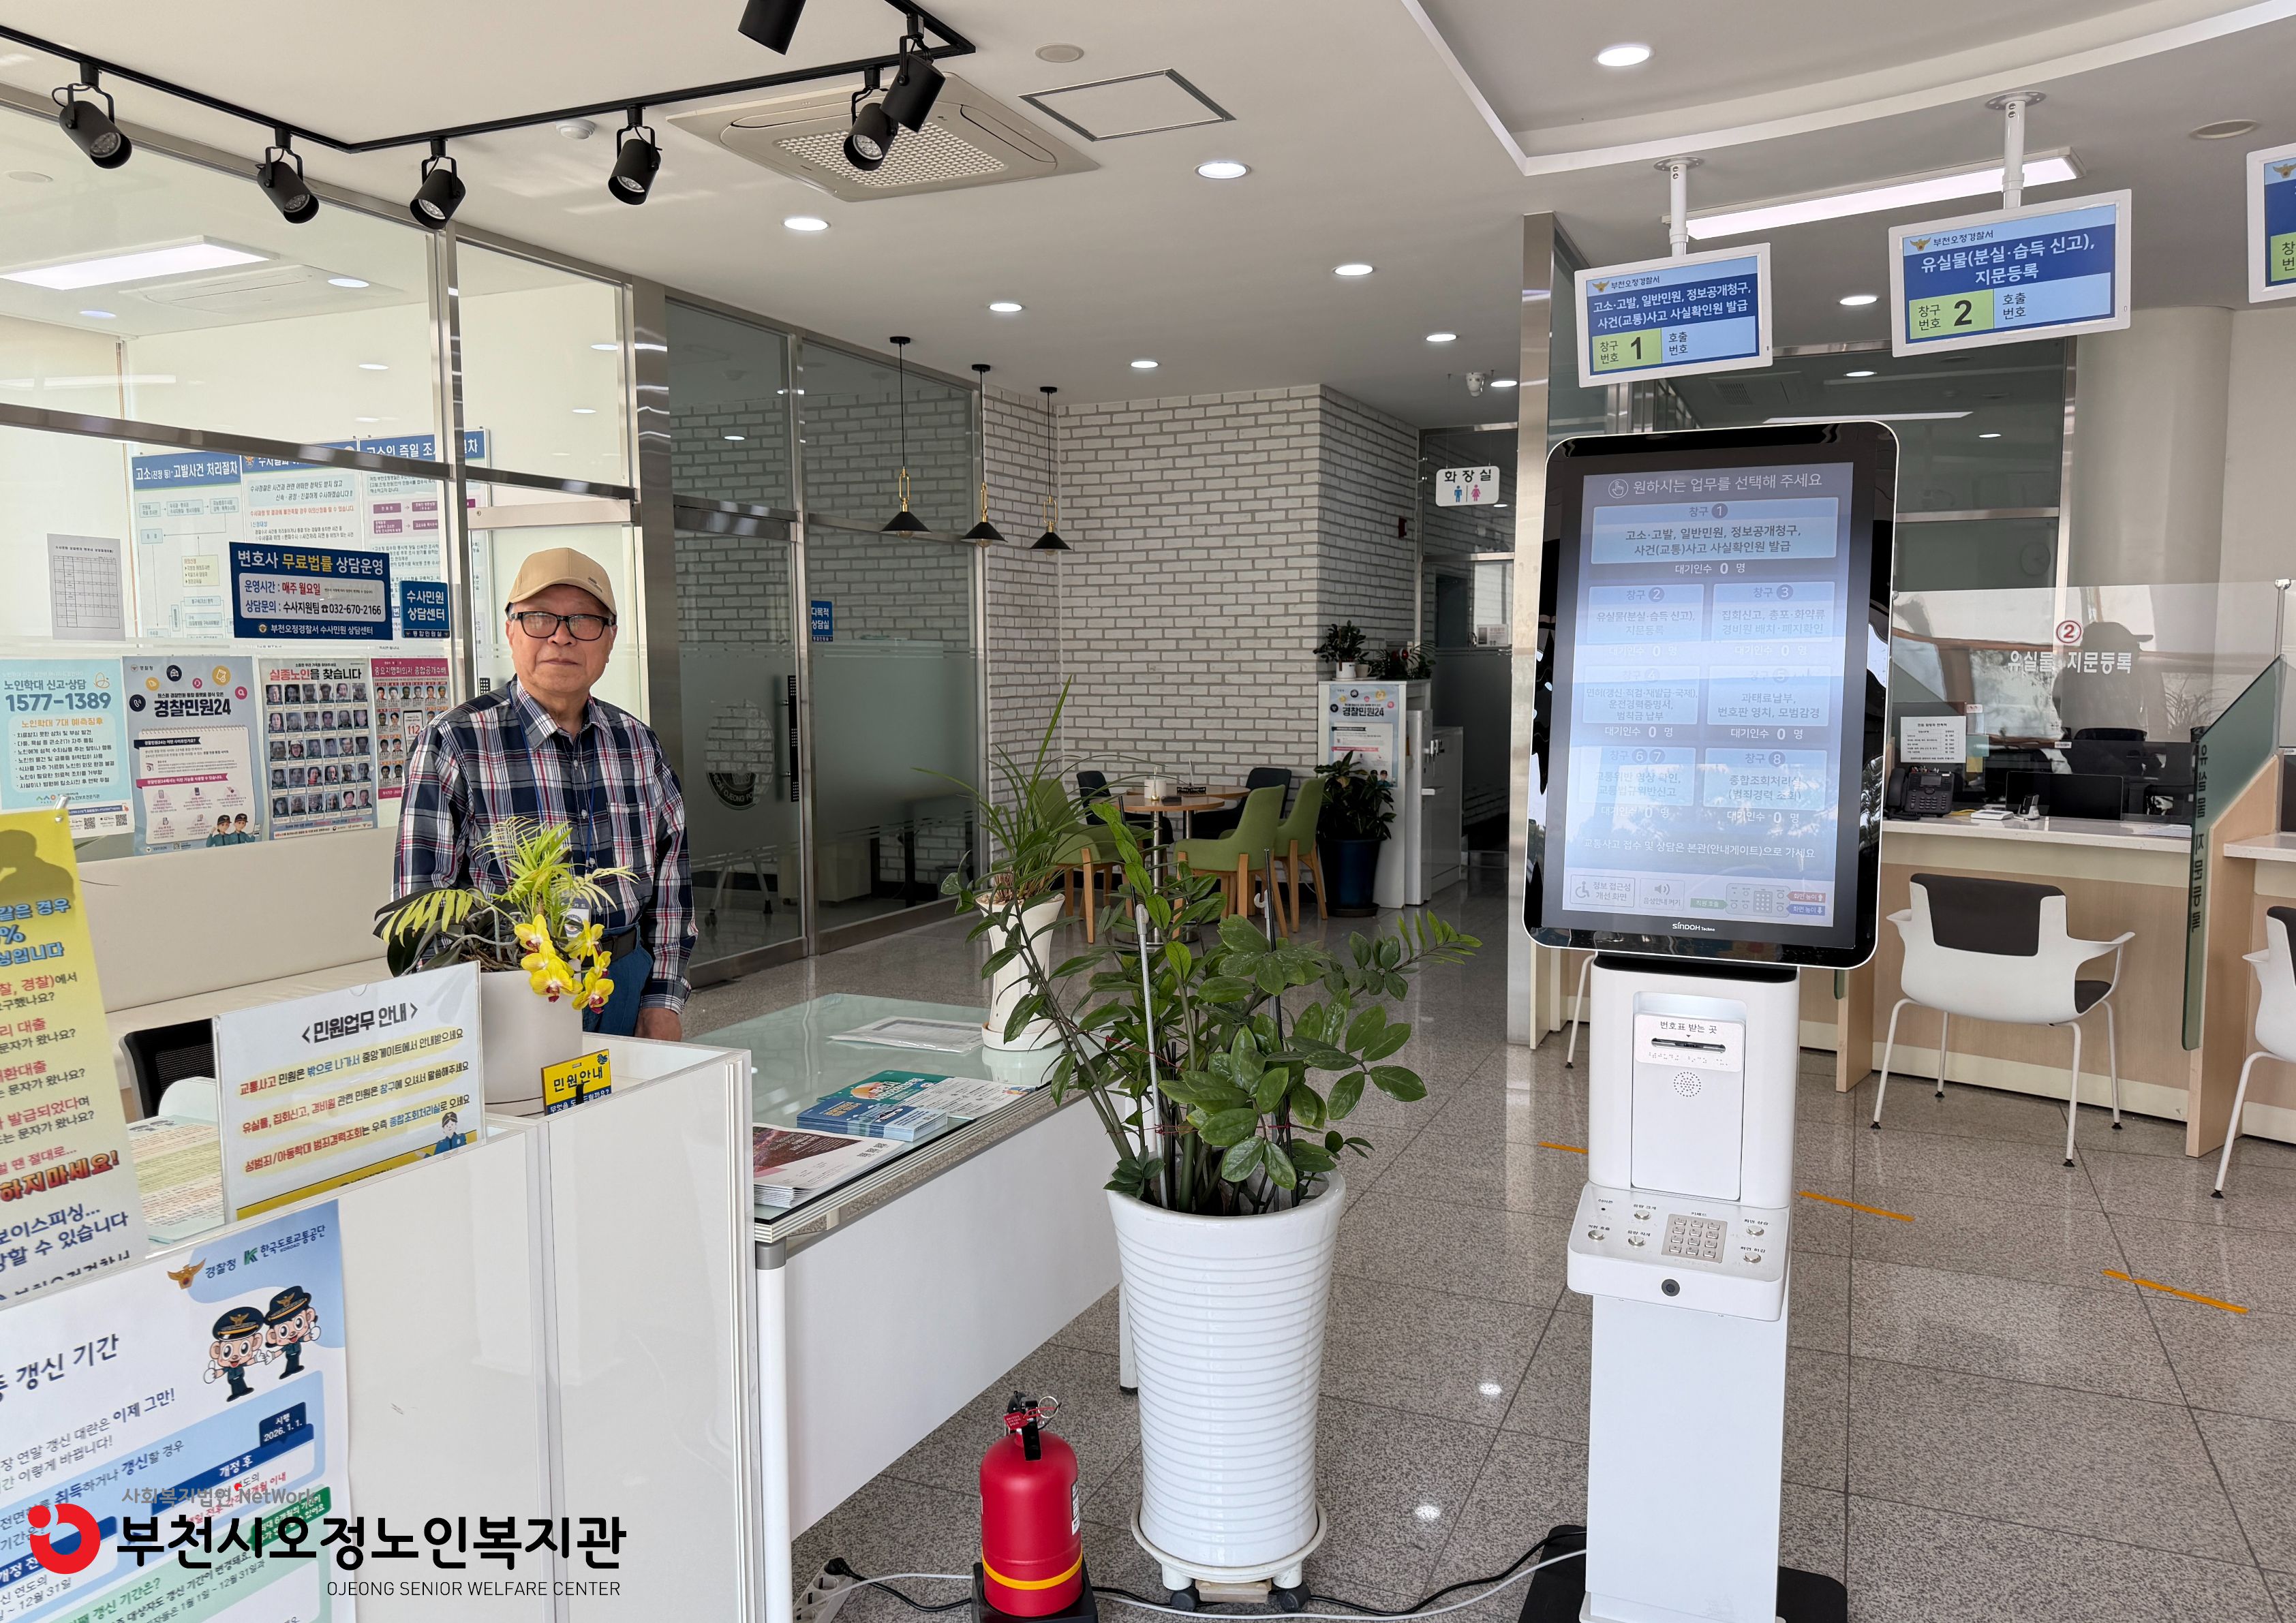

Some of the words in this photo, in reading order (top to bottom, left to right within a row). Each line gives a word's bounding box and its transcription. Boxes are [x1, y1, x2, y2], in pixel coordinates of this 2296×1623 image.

[1933, 230, 1993, 247] 부천오정경찰서
[1921, 242, 2045, 272] 유실물(분실·습득
[2050, 234, 2094, 253] 신고),
[1975, 263, 2039, 285] 지문등록
[1611, 276, 1660, 290] 부천오정경찰서
[1593, 298, 1640, 313] 고소·고발,
[1641, 290, 1685, 307] 일반민원,
[1687, 282, 1751, 301] 정보공개청구,
[2003, 292, 2025, 305] 호출
[1597, 310, 1667, 329] 사건(교통)사고
[1670, 303, 1723, 320] 사실확인원
[1726, 300, 1747, 313] 발급
[1918, 305, 1941, 318] 창구
[1954, 300, 1972, 326] 2
[2004, 307, 2026, 320] 번호
[1919, 318, 1941, 331] 번호
[1669, 332, 1687, 343] 호출
[1600, 341, 1619, 352] 창구
[1631, 337, 1641, 360] 1
[1669, 344, 1688, 356] 번호
[1600, 353, 1619, 365] 번호
[207, 461, 237, 476] 처리절차
[1444, 469, 1492, 482] 화장실
[1634, 478, 1687, 495] 원하시는
[1690, 477, 1730, 492] 업무를
[1735, 475, 1776, 490] 선택해
[1780, 473, 1822, 488] 주세요
[1689, 506, 1709, 518] 창구
[1625, 528, 1677, 541] 고소·고발,
[1680, 526, 1727, 540] 일반민원,
[1730, 524, 1801, 538] 정보공개청구,
[1635, 543, 1707, 557] 사건(교통)사고
[1710, 542, 1765, 555] 사실확인원
[1769, 540, 1792, 553] 발급
[238, 551, 278, 569] 변호사
[282, 553, 332, 572] 무료법률
[336, 558, 384, 575] 상담운영
[1675, 563, 1712, 575] 대기인수
[1719, 563, 1728, 574] 0
[1736, 562, 1745, 574] 명
[245, 581, 276, 593] 운영시간
[282, 582, 297, 594] 매주
[299, 583, 320, 595] 월요일
[407, 590, 444, 604] 수사민원
[245, 600, 277, 613] 상담문의
[283, 601, 320, 614] 수사지원팀
[408, 607, 445, 621] 상담센터
[811, 607, 829, 617] 다목적
[271, 624, 319, 634] 부천오정경찰서
[320, 625, 347, 634] 수사민원
[348, 626, 373, 635] 상담센터
[812, 620, 829, 630] 상담실
[375, 667, 412, 675] 중요지명피의자
[2008, 651, 2053, 673] 유실물
[2067, 651, 2132, 675] 지문등록
[270, 668, 320, 681] 실종노인을
[323, 668, 361, 680] 찾습니다
[4, 680, 44, 691] 노인학대
[47, 679, 87, 690] 신고·상담
[5, 692, 111, 711] 1577-1389
[154, 698, 231, 717] 경찰민원24
[1343, 707, 1383, 717] 경찰민원24
[1718, 707, 1749, 718] 번호판
[1751, 707, 1774, 720] 영치,
[1779, 707, 1820, 720] 모범감경
[22, 720, 52, 728] 노인학대
[56, 718, 68, 726] 7대
[408, 725, 420, 735] 112
[1605, 726, 1641, 737] 대기인수
[1584, 838, 1620, 850] 교통사고
[1623, 839, 1641, 851] 접수
[1644, 840, 1653, 851] 및
[1656, 841, 1683, 852] 상담은
[1687, 842, 1782, 858] 본관(안내게이트)으로
[1786, 846, 1816, 859] 가세요
[36, 898, 70, 915] 경우
[22, 972, 78, 993] 경찰)에서
[18, 1018, 46, 1035] 대출
[1660, 1021, 1685, 1031] 번호표
[1689, 1024, 1704, 1033] 받는
[1709, 1025, 1717, 1034] 곳
[36, 1028, 76, 1047] 왔나요?
[240, 1076, 277, 1096] 교통사고
[279, 1069, 305, 1085] 민원은
[307, 1061, 333, 1077] 밖으로
[335, 1054, 361, 1070] 나가서
[363, 1040, 418, 1064] 중앙게이트에서
[419, 1028, 463, 1050] 안내받으세요
[8, 1080, 43, 1096] 문자가
[46, 1068, 85, 1087] 왔나요?
[553, 1066, 602, 1092] 민원안내
[243, 1117, 271, 1134] 유실물,
[273, 1107, 309, 1125] 집회신고,
[311, 1098, 336, 1115] 경비원
[337, 1094, 354, 1107] 관련
[355, 1086, 379, 1102] 민원은
[380, 1079, 403, 1095] 창구에
[405, 1072, 427, 1087] 오셔서
[428, 1062, 469, 1081] 말씀해주세요
[8, 1096, 89, 1127] 발급되었다며
[18, 1124, 52, 1141] 문자가
[55, 1110, 94, 1130] 왔나요?
[313, 1126, 370, 1152] 범죄경력조회는
[371, 1119, 388, 1133] 우측
[389, 1100, 448, 1128] 종합조회처리실로
[449, 1094, 470, 1110] 오세요
[35, 1240, 53, 1256] 수
[58, 1211, 128, 1250] 있습니다
[205, 1258, 236, 1280] 경찰청
[260, 1224, 326, 1258] 한국도로교통공단
[16, 1352, 65, 1391] 갱신
[72, 1333, 119, 1367] 기간
[17, 1445, 42, 1465] 연말
[46, 1434, 70, 1453] 갱신
[112, 1402, 140, 1424] 이제
[144, 1387, 175, 1413] 그만!
[275, 1414, 290, 1426] 시행
[18, 1459, 57, 1481] 이렇게
[59, 1435, 112, 1464] 바뀝니다!
[219, 1460, 240, 1477] 개정
[242, 1455, 253, 1468] 후
[55, 1469, 119, 1505] 취득하거나
[122, 1451, 159, 1476] 갱신할
[163, 1440, 185, 1457] 경우
